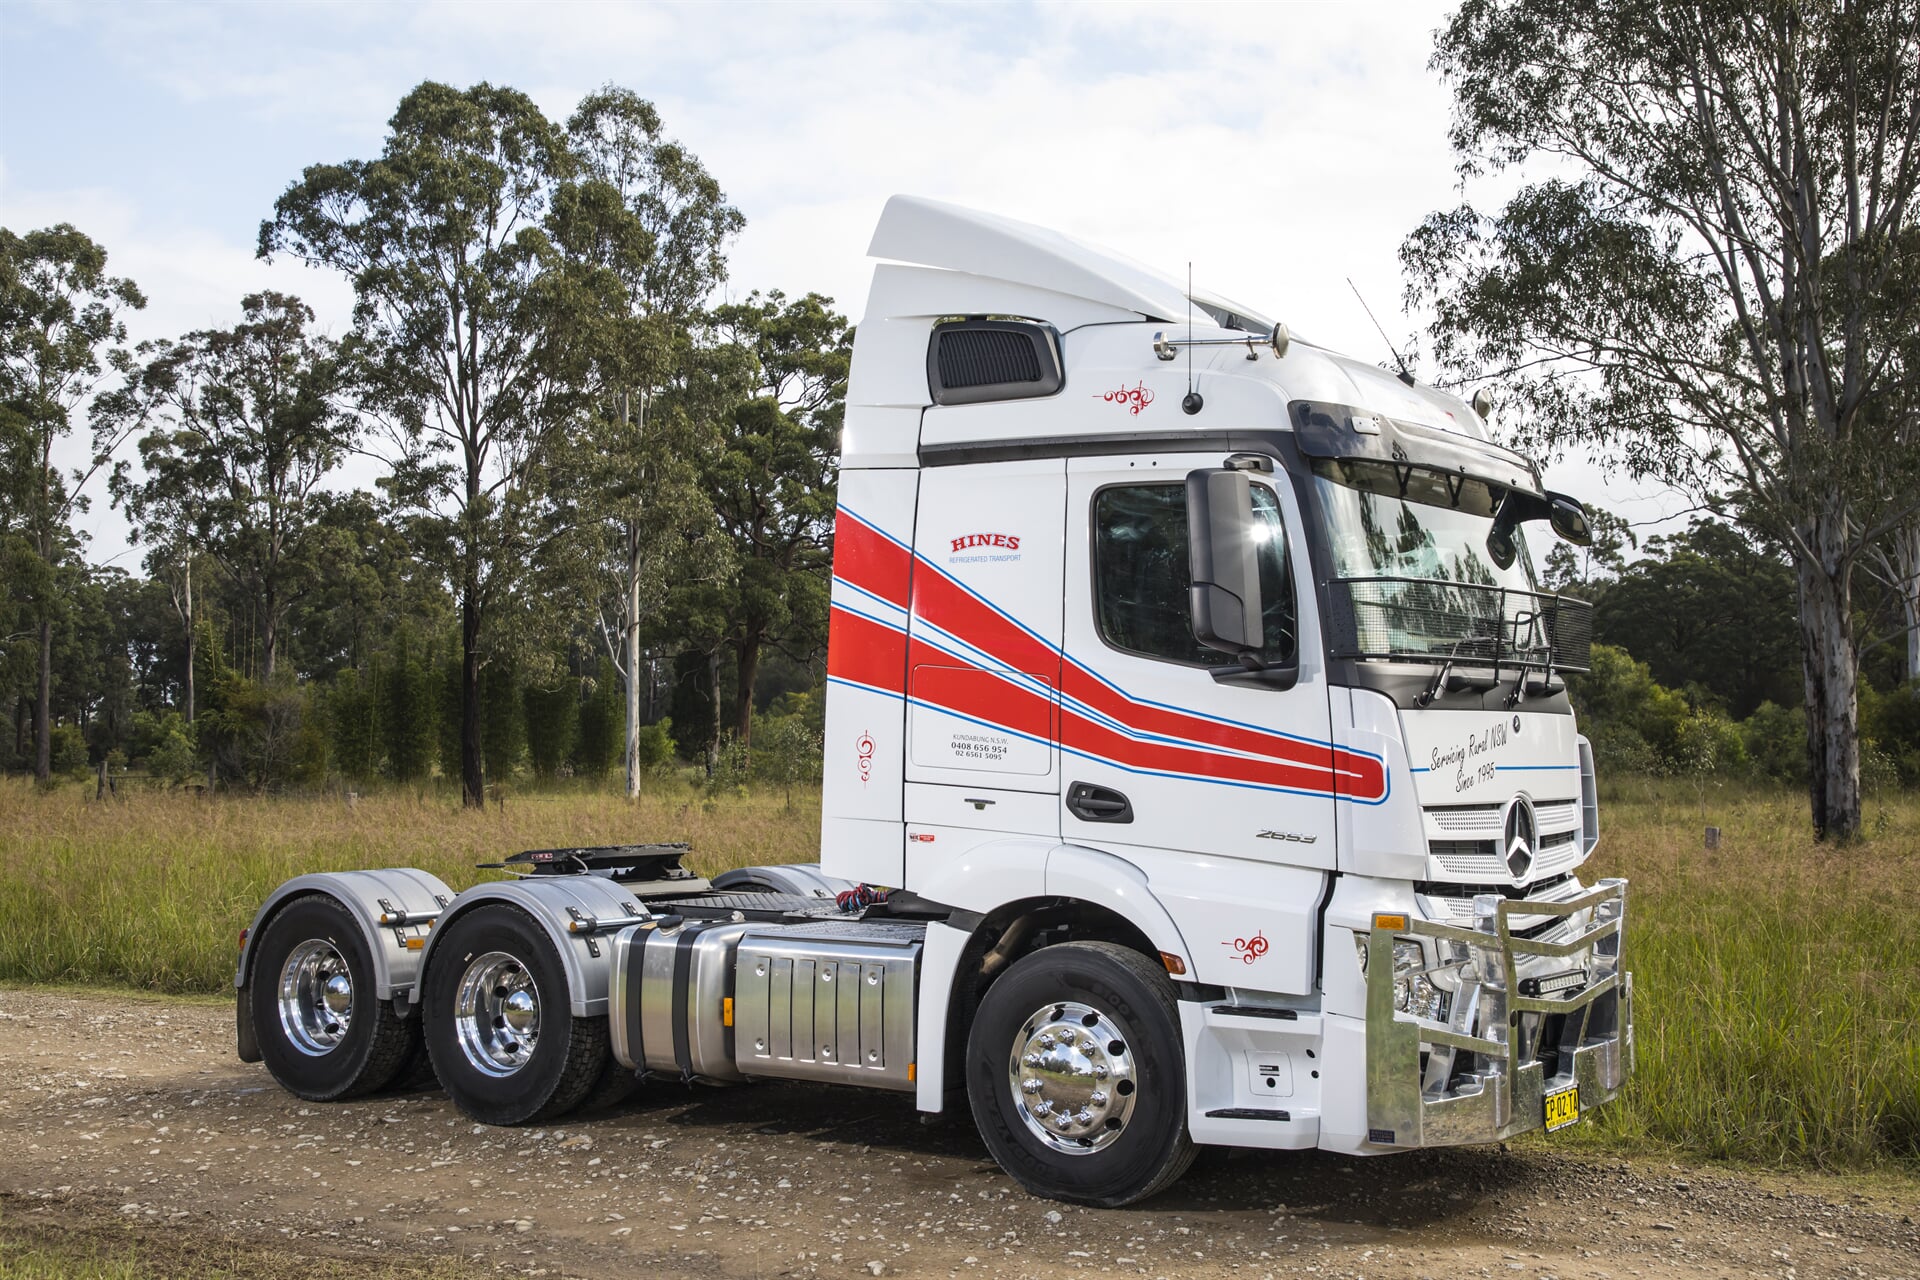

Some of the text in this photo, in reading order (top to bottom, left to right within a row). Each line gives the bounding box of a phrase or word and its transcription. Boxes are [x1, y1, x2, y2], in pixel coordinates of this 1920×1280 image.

[950, 533, 1020, 552] HINES
[989, 554, 1021, 562] TRANSPORT
[953, 734, 989, 743] KUNDABUNG
[951, 742, 1007, 754] 0408 656 954
[1430, 720, 1508, 771] Servicing Rural NSW
[966, 751, 982, 759] 6561
[1455, 762, 1495, 793] Since 1995
[1255, 829, 1317, 844] 2653
